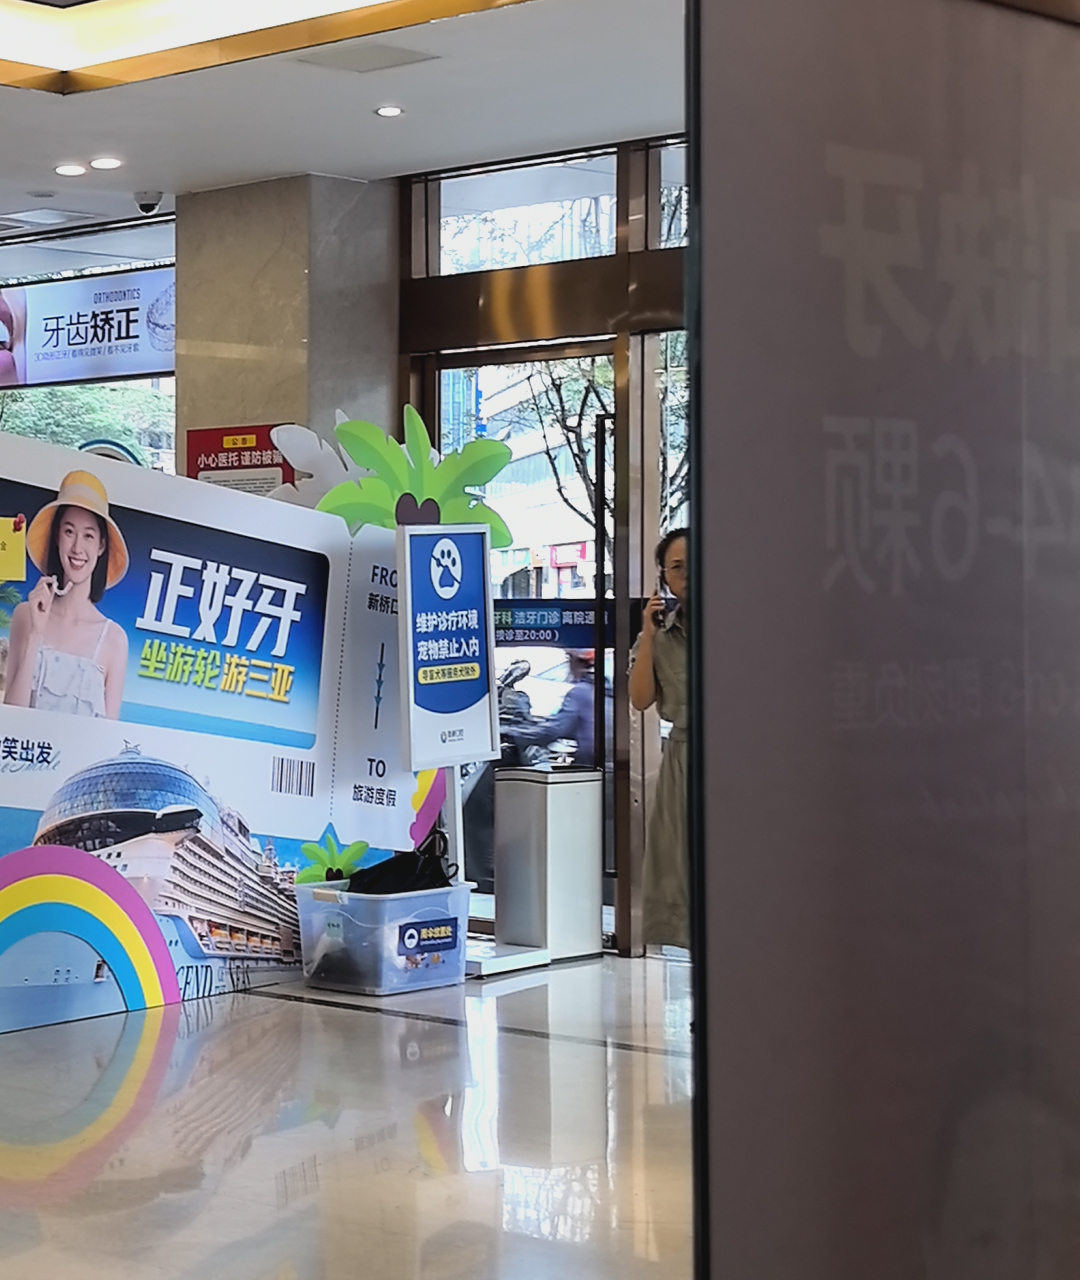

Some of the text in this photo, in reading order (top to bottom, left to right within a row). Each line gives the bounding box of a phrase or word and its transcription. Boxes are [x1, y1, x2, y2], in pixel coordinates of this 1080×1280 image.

[93, 288, 141, 305] ORTHODONTICS
[42, 307, 140, 348] 牙齿矫正
[198, 451, 240, 468] 小心医托
[371, 564, 398, 589] FRO
[135, 547, 307, 658] 正好牙
[366, 592, 398, 616] 新桥口
[415, 609, 479, 633] 维护诊疗环境
[514, 611, 560, 625] 洁牙门诊
[562, 610, 608, 625] 离院通
[417, 636, 480, 661] 宠物禁止入内
[366, 757, 386, 778] TO
[352, 782, 397, 807] 旅游度假
